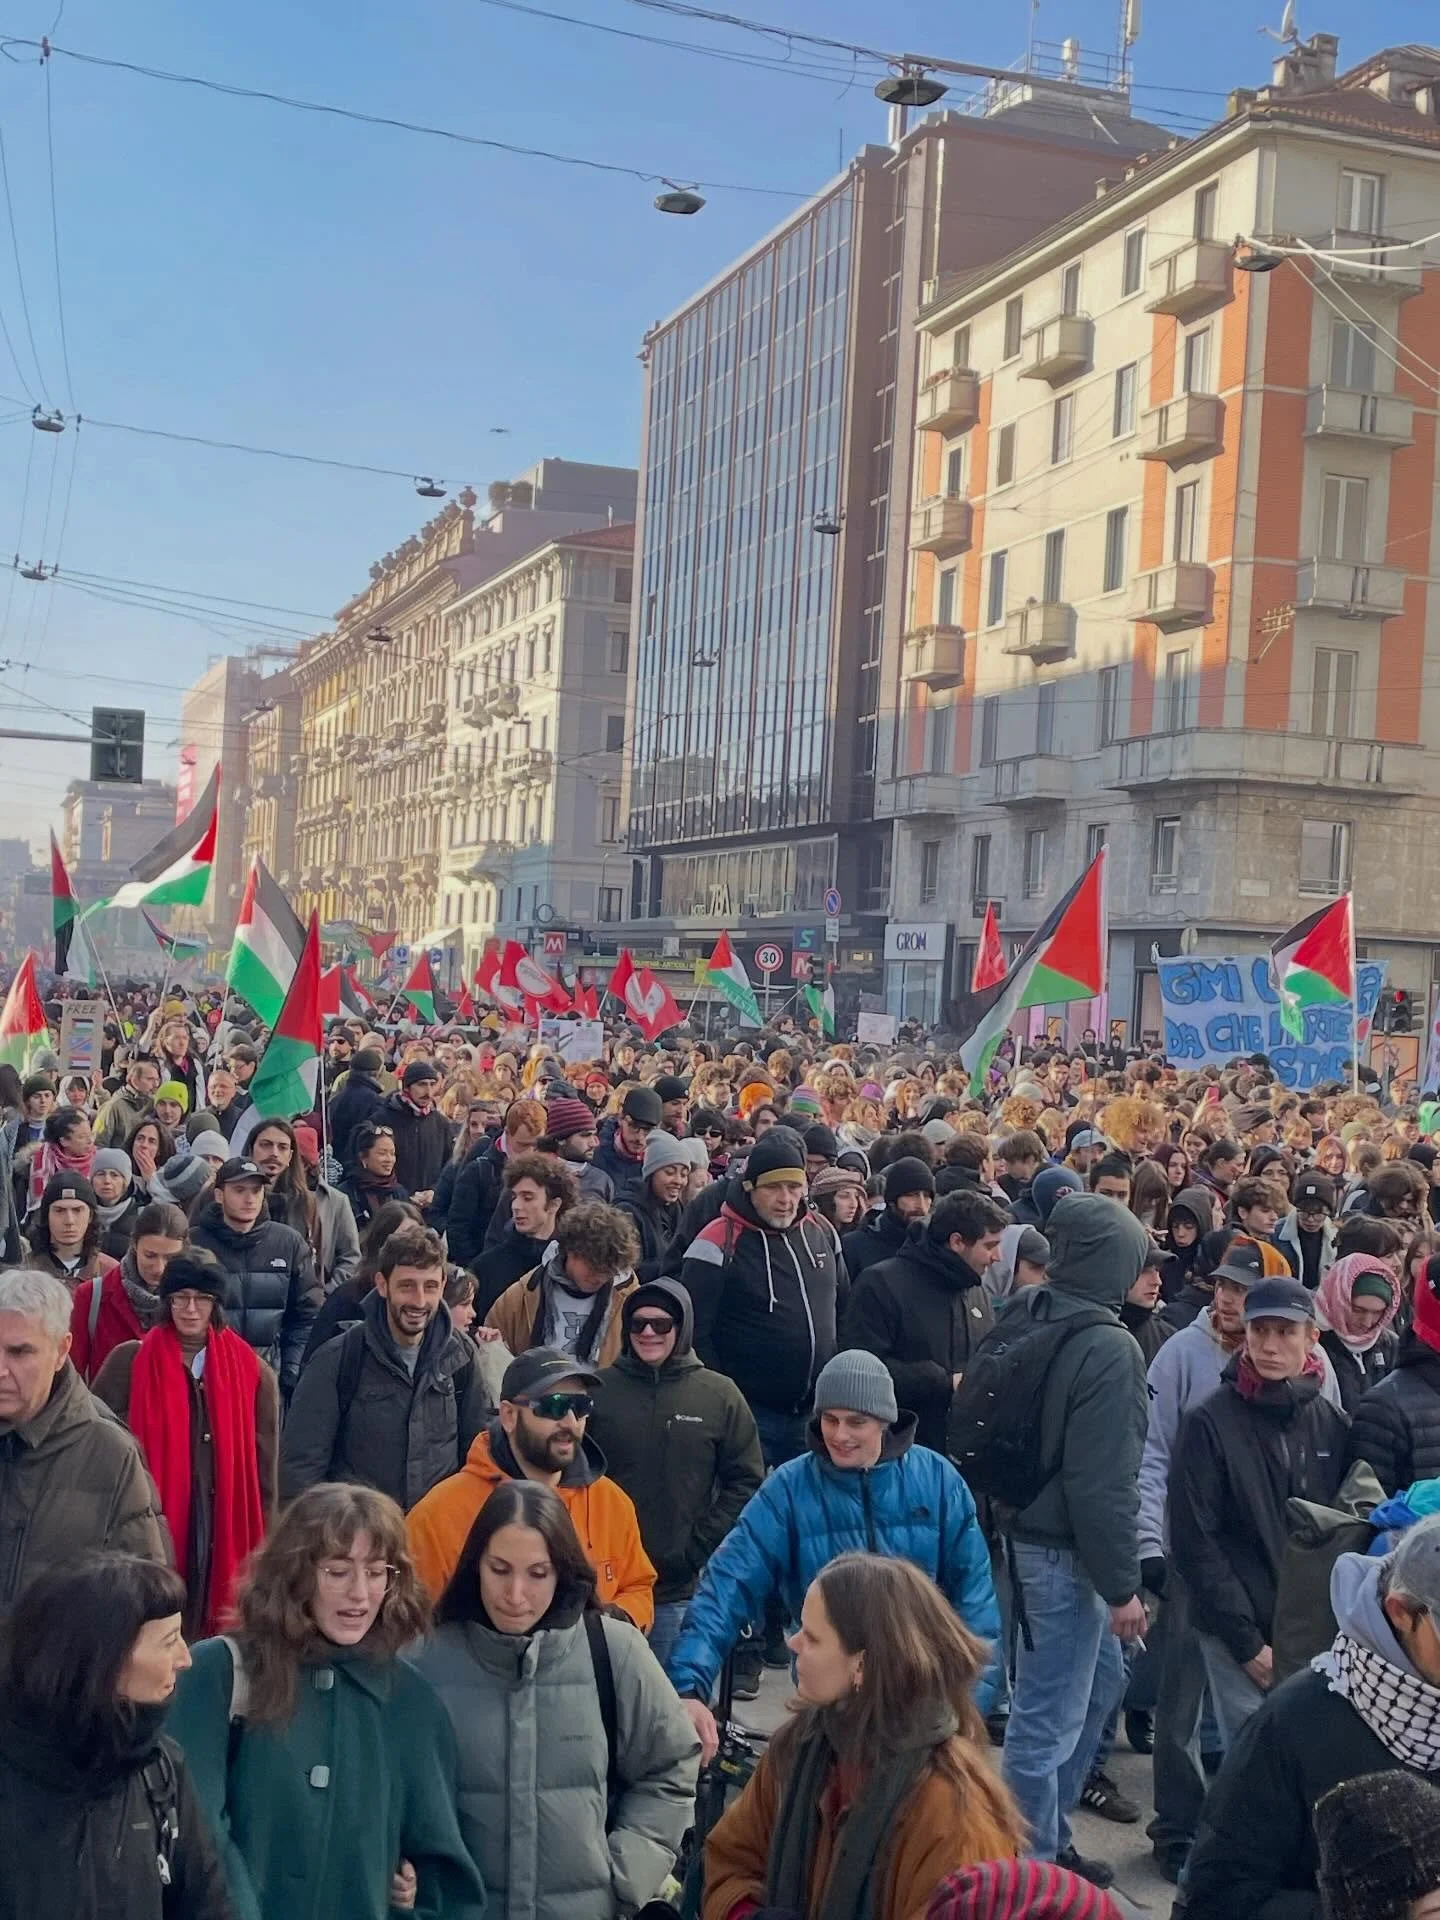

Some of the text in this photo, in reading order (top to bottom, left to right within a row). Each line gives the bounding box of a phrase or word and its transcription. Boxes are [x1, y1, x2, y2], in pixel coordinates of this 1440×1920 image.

[547, 937, 562, 951] M
[799, 930, 816, 948] S
[896, 931, 927, 951] GROM
[762, 952, 776, 964] 30
[65, 1004, 97, 1014] FREE
[1164, 1016, 1206, 1059] DA
[1206, 1013, 1264, 1053] CHE
